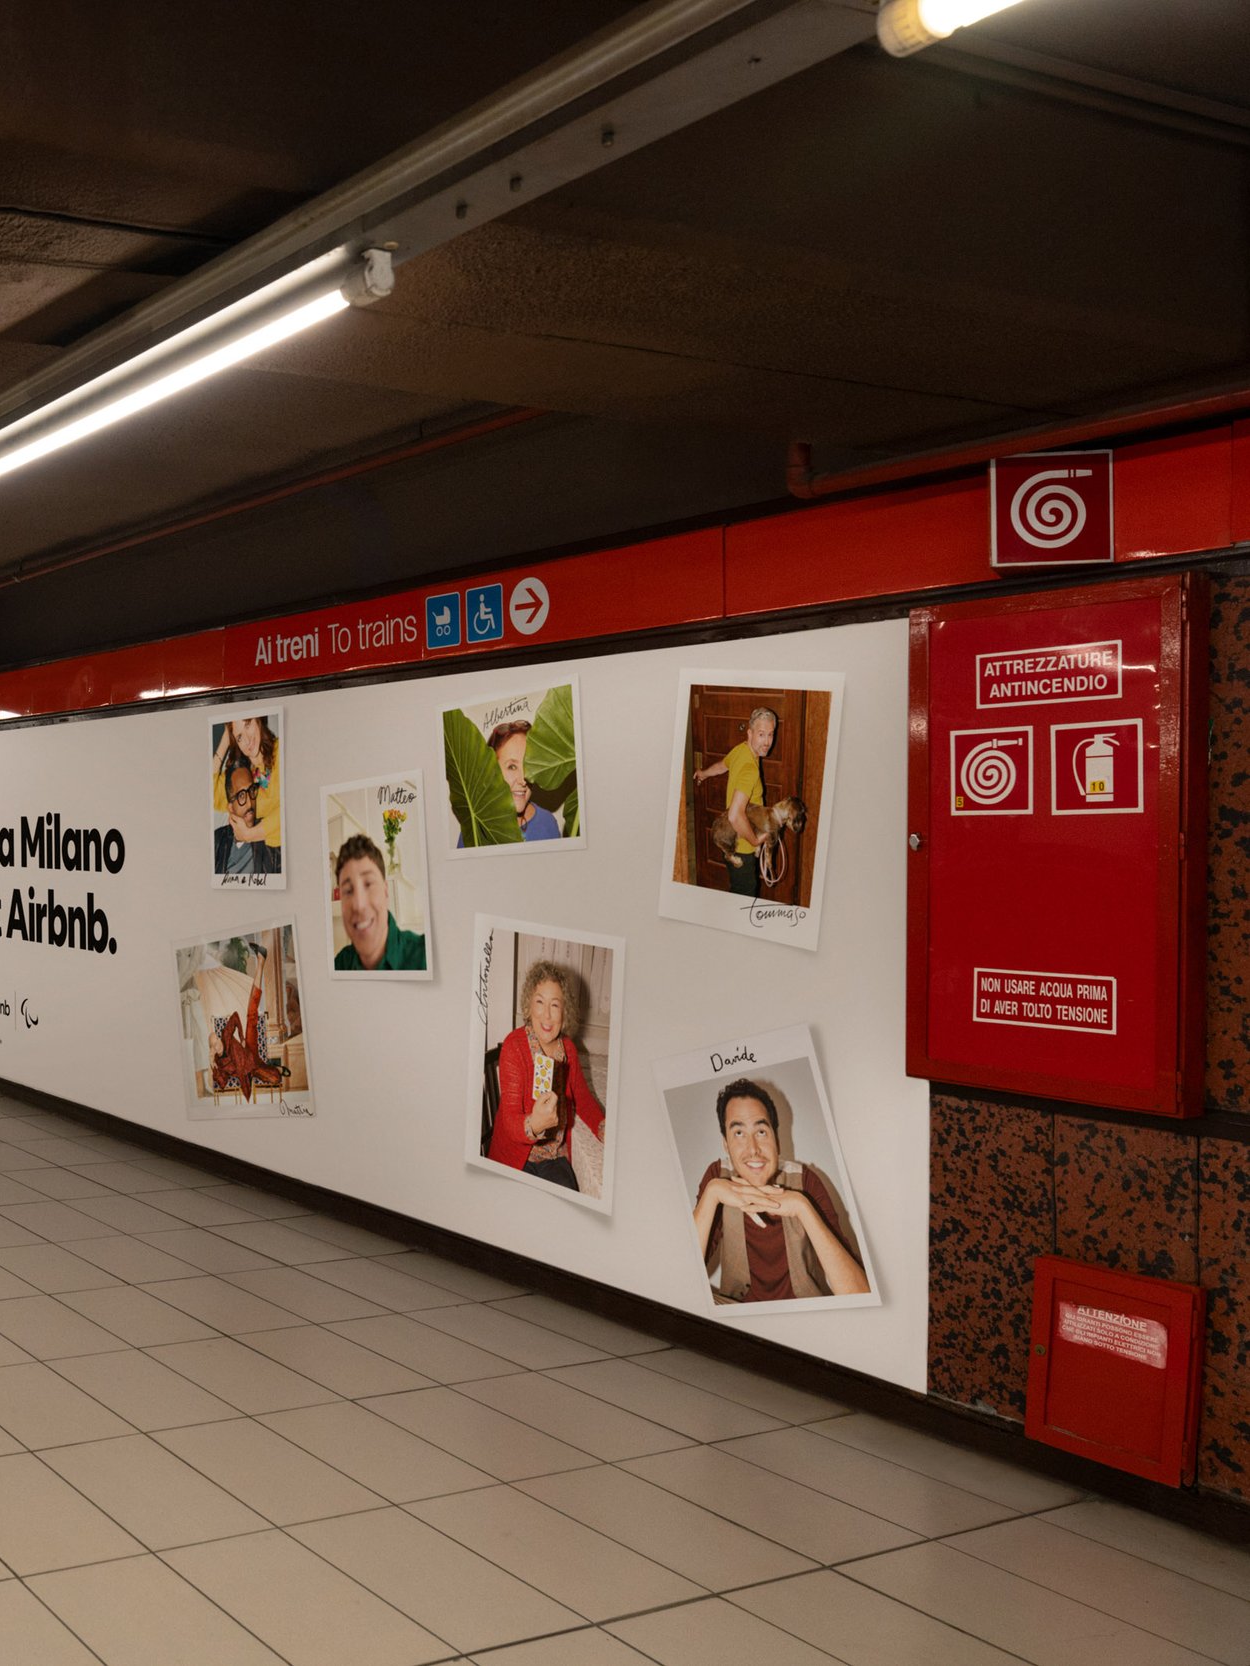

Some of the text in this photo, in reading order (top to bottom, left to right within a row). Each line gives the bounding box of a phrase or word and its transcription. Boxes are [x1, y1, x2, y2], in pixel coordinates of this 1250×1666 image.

[255, 614, 417, 666] Ai treni To trains
[984, 650, 1113, 677] ATTREZZATURE
[989, 674, 1108, 698] ANTINCENDIO
[377, 785, 417, 805] Matteo
[20, 812, 126, 874] Milano
[6, 886, 118, 955] Airbnb.
[740, 896, 806, 928] Tommaso
[981, 977, 1108, 1001] NON USARE ACQUA PRIMA
[980, 998, 1108, 1024] DI AVER TOLTO TENSIONE
[710, 1046, 757, 1072] Davide
[1077, 1305, 1147, 1330] ATTENZIONE
[1102, 1322, 1132, 1336] POSSONO
[1096, 1328, 1114, 1337] SOLO
[1093, 1340, 1115, 1351] SOTTO
